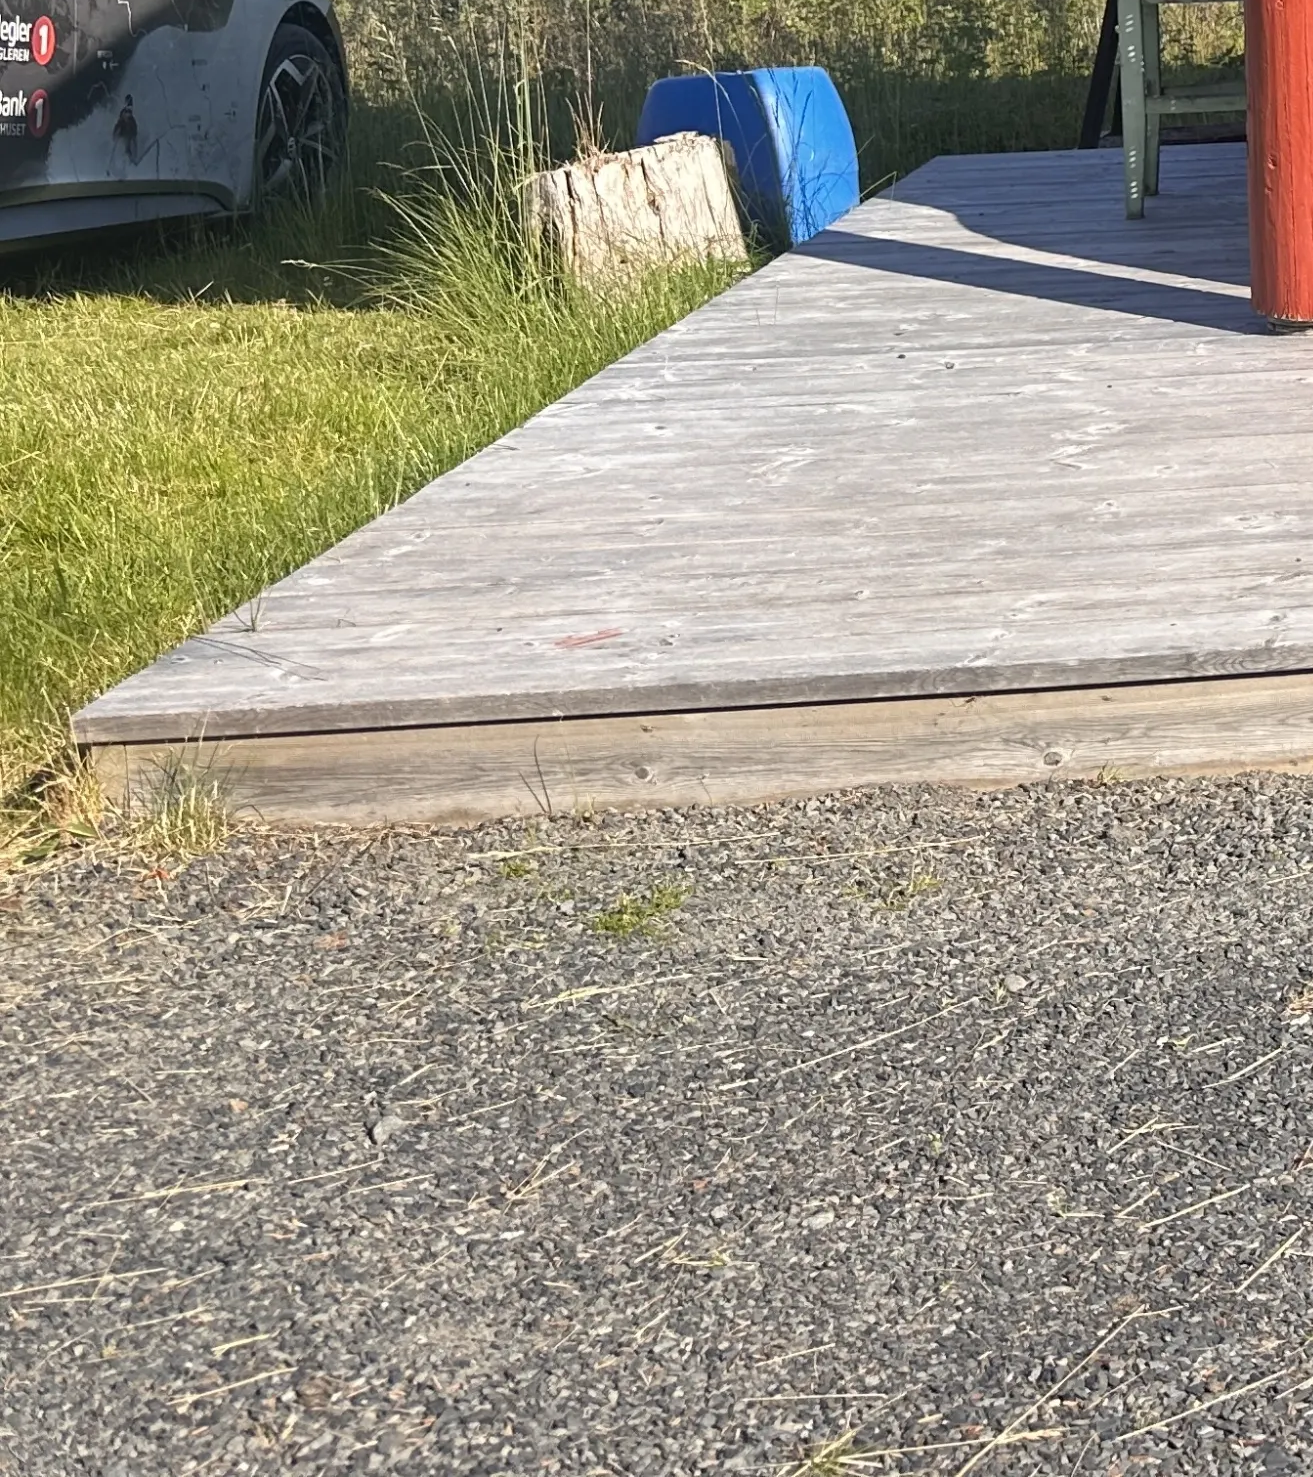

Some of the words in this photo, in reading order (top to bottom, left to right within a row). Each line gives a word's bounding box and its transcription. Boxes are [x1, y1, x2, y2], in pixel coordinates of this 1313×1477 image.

[0, 14, 32, 47] egler
[39, 24, 48, 56] 1
[35, 98, 44, 129] 1
